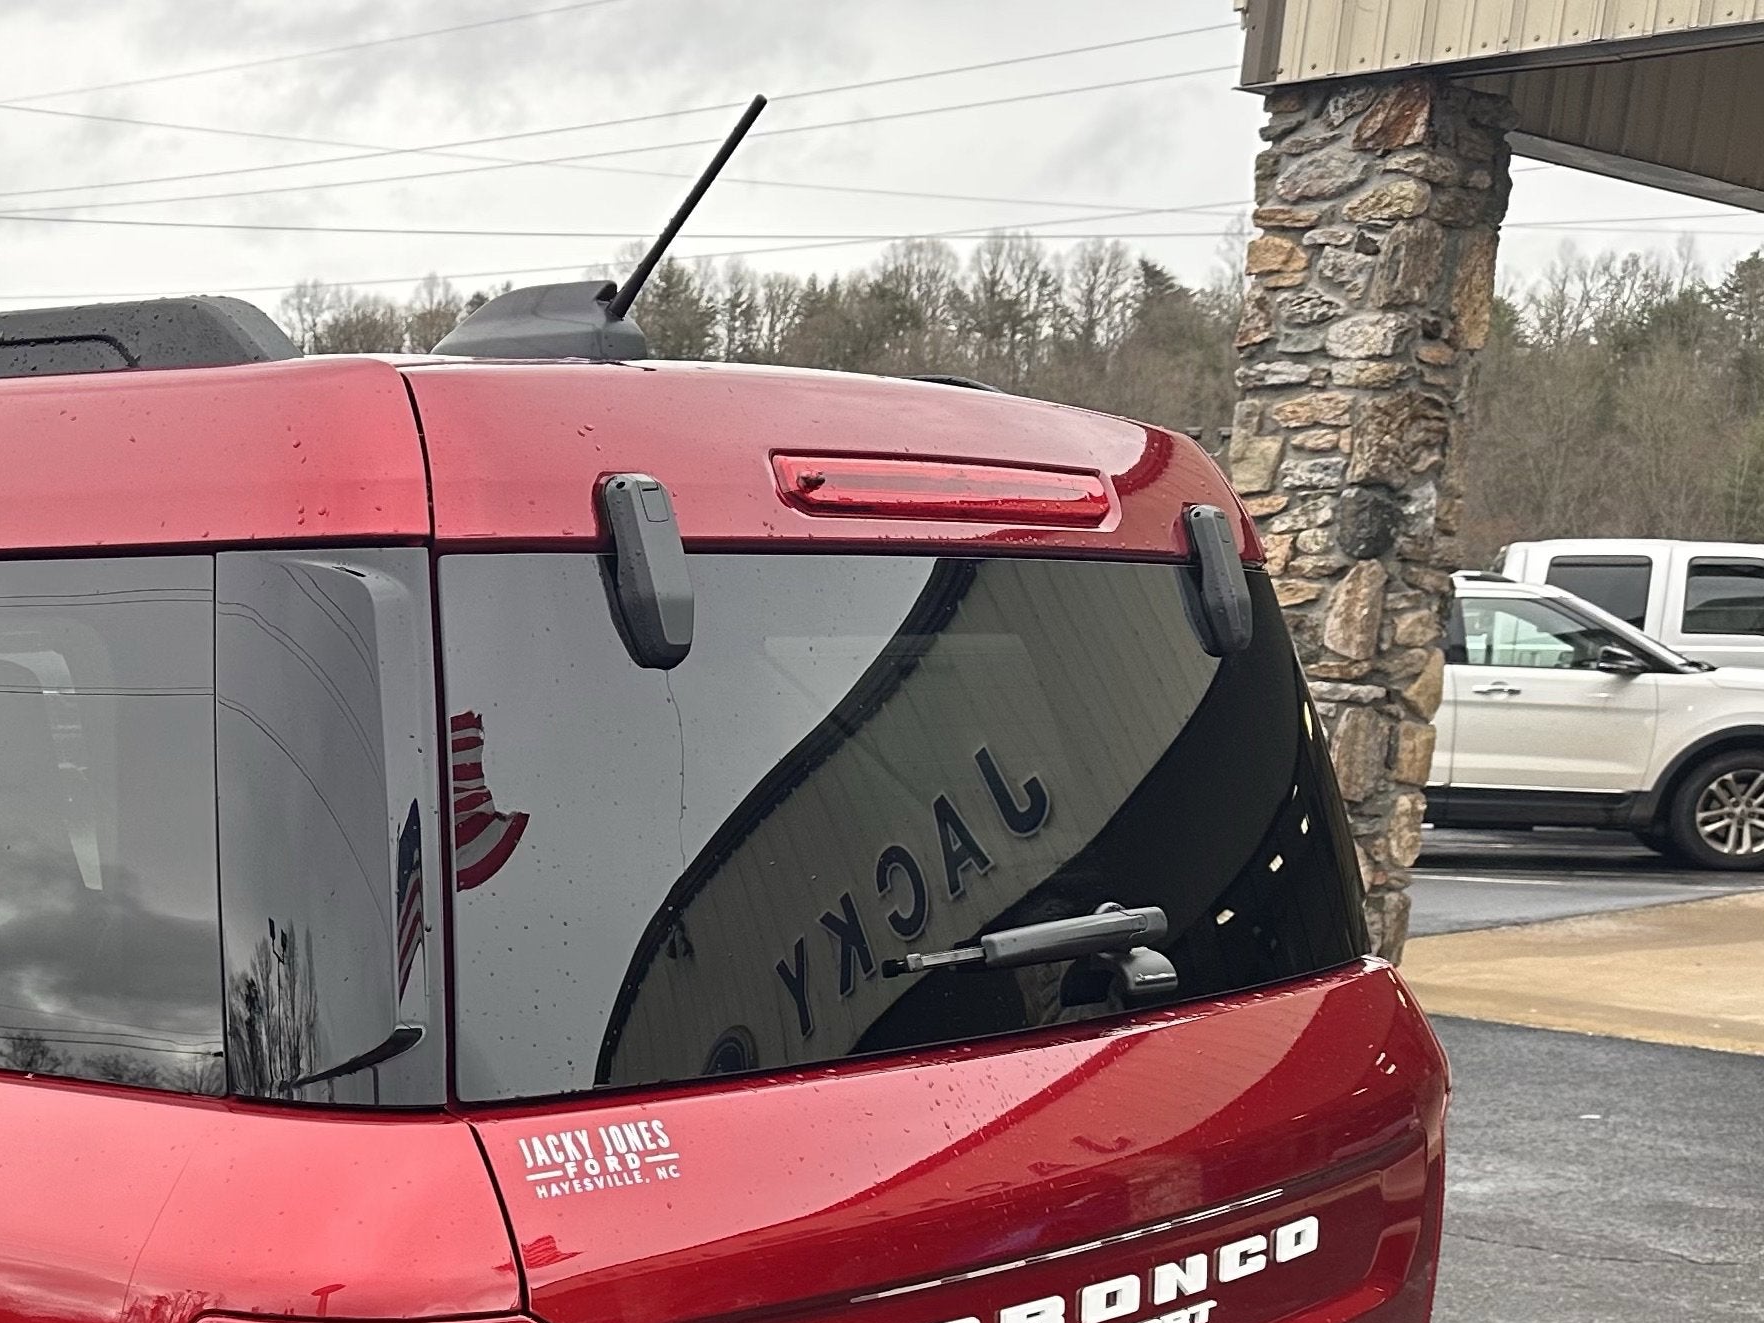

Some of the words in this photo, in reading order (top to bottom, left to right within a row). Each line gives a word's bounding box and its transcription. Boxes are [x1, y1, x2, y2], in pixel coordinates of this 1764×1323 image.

[518, 1129, 595, 1169] JACKY
[598, 1119, 671, 1156] JONES
[564, 1152, 641, 1179] FORD
[655, 1164, 681, 1181] NC
